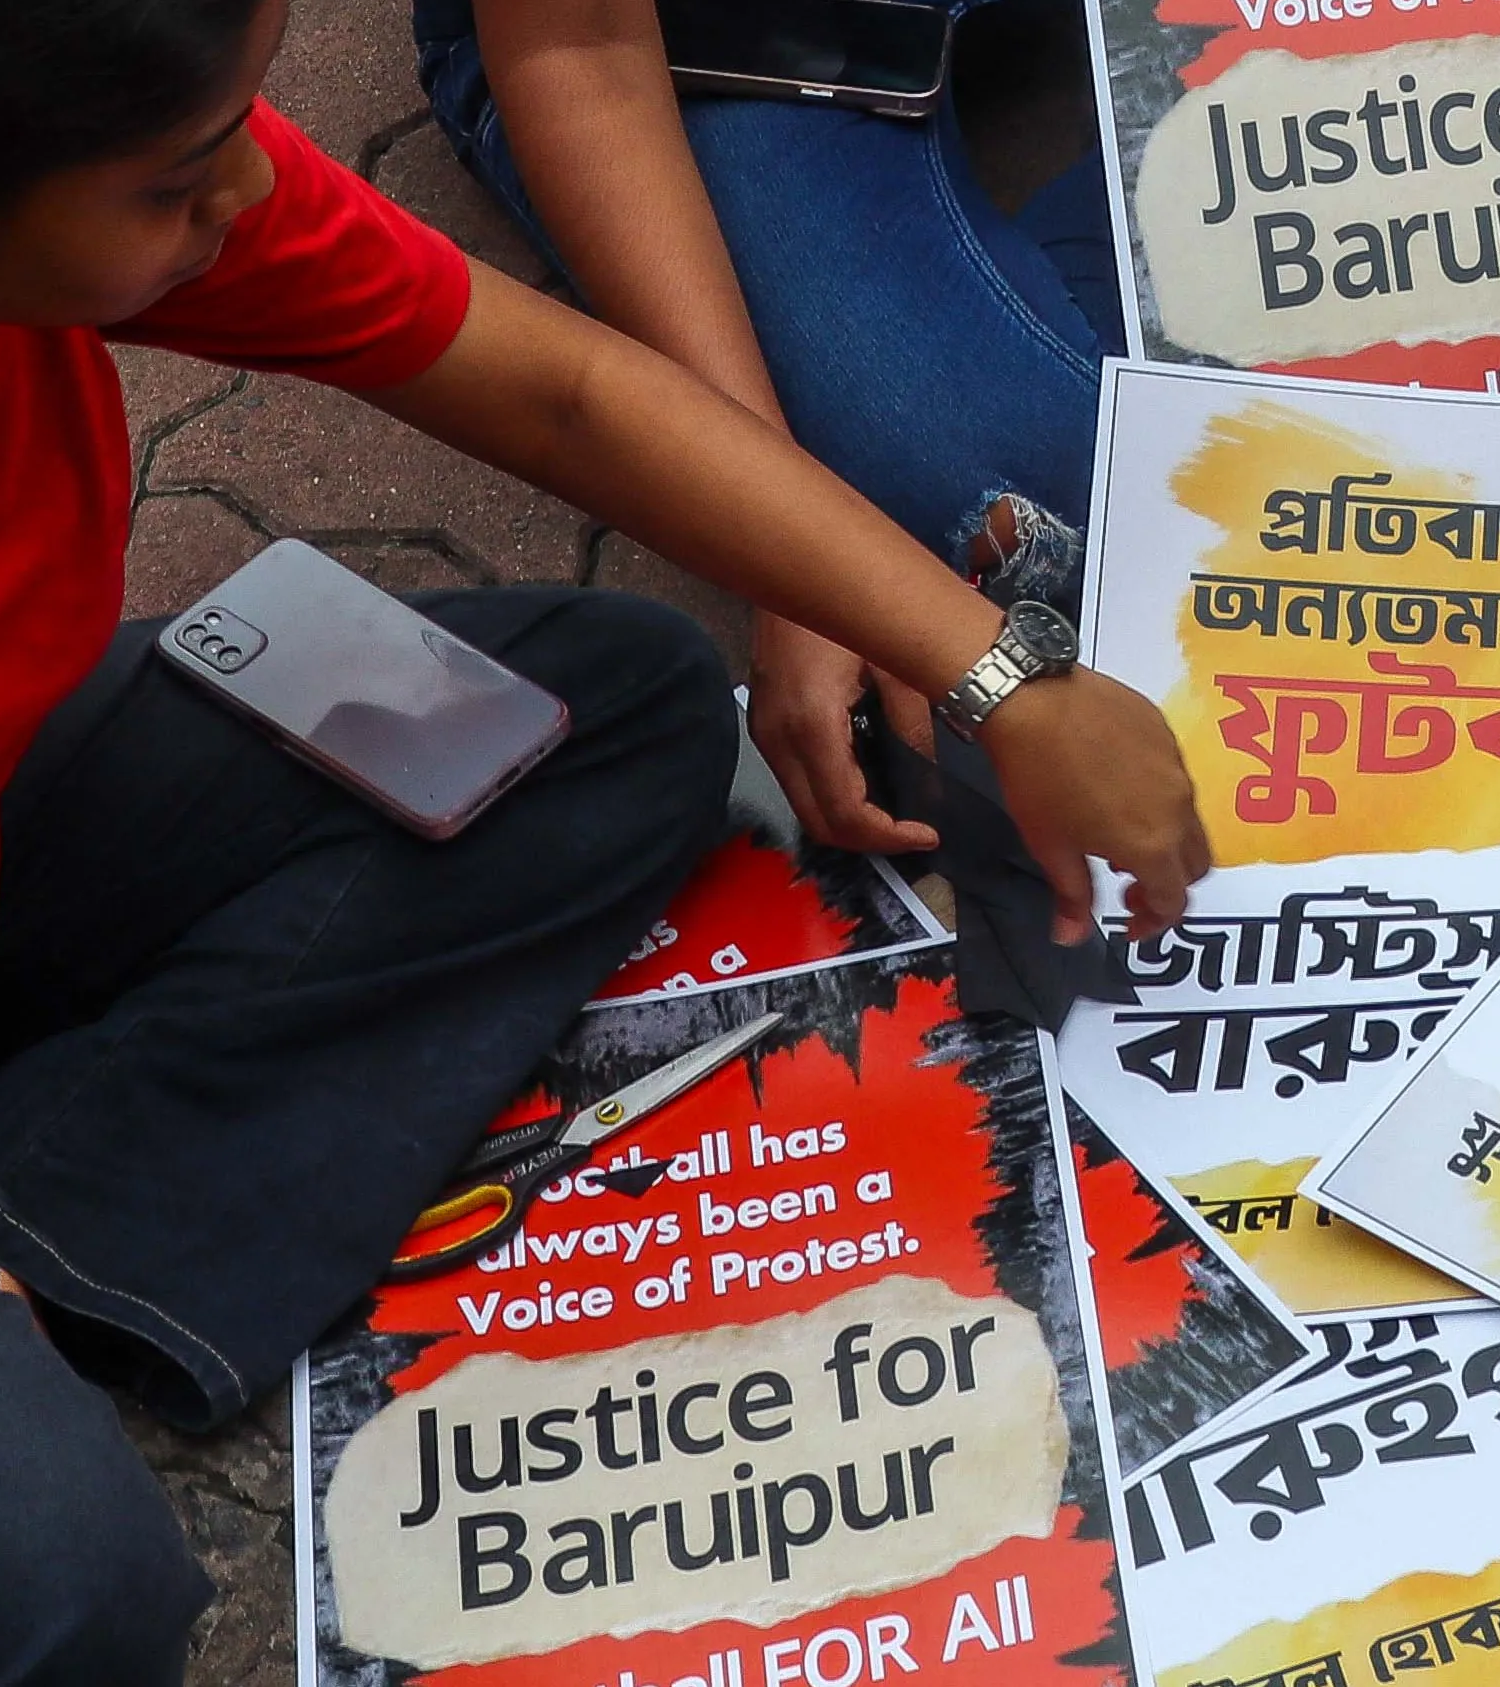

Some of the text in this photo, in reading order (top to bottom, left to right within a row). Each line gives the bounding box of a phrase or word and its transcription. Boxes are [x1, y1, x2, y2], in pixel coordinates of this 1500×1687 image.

[711, 944, 748, 974] a
[502, 1145, 563, 1183] MEYER
[749, 1120, 847, 1167] has
[699, 1185, 836, 1238] been
[857, 1171, 892, 1203] a
[457, 1222, 920, 1336] Voice of Protest.
[400, 1316, 996, 1527] Justice for
[457, 1435, 954, 1612] Baruipur
[763, 1614, 920, 1687] FOR
[941, 1574, 1036, 1663] All
